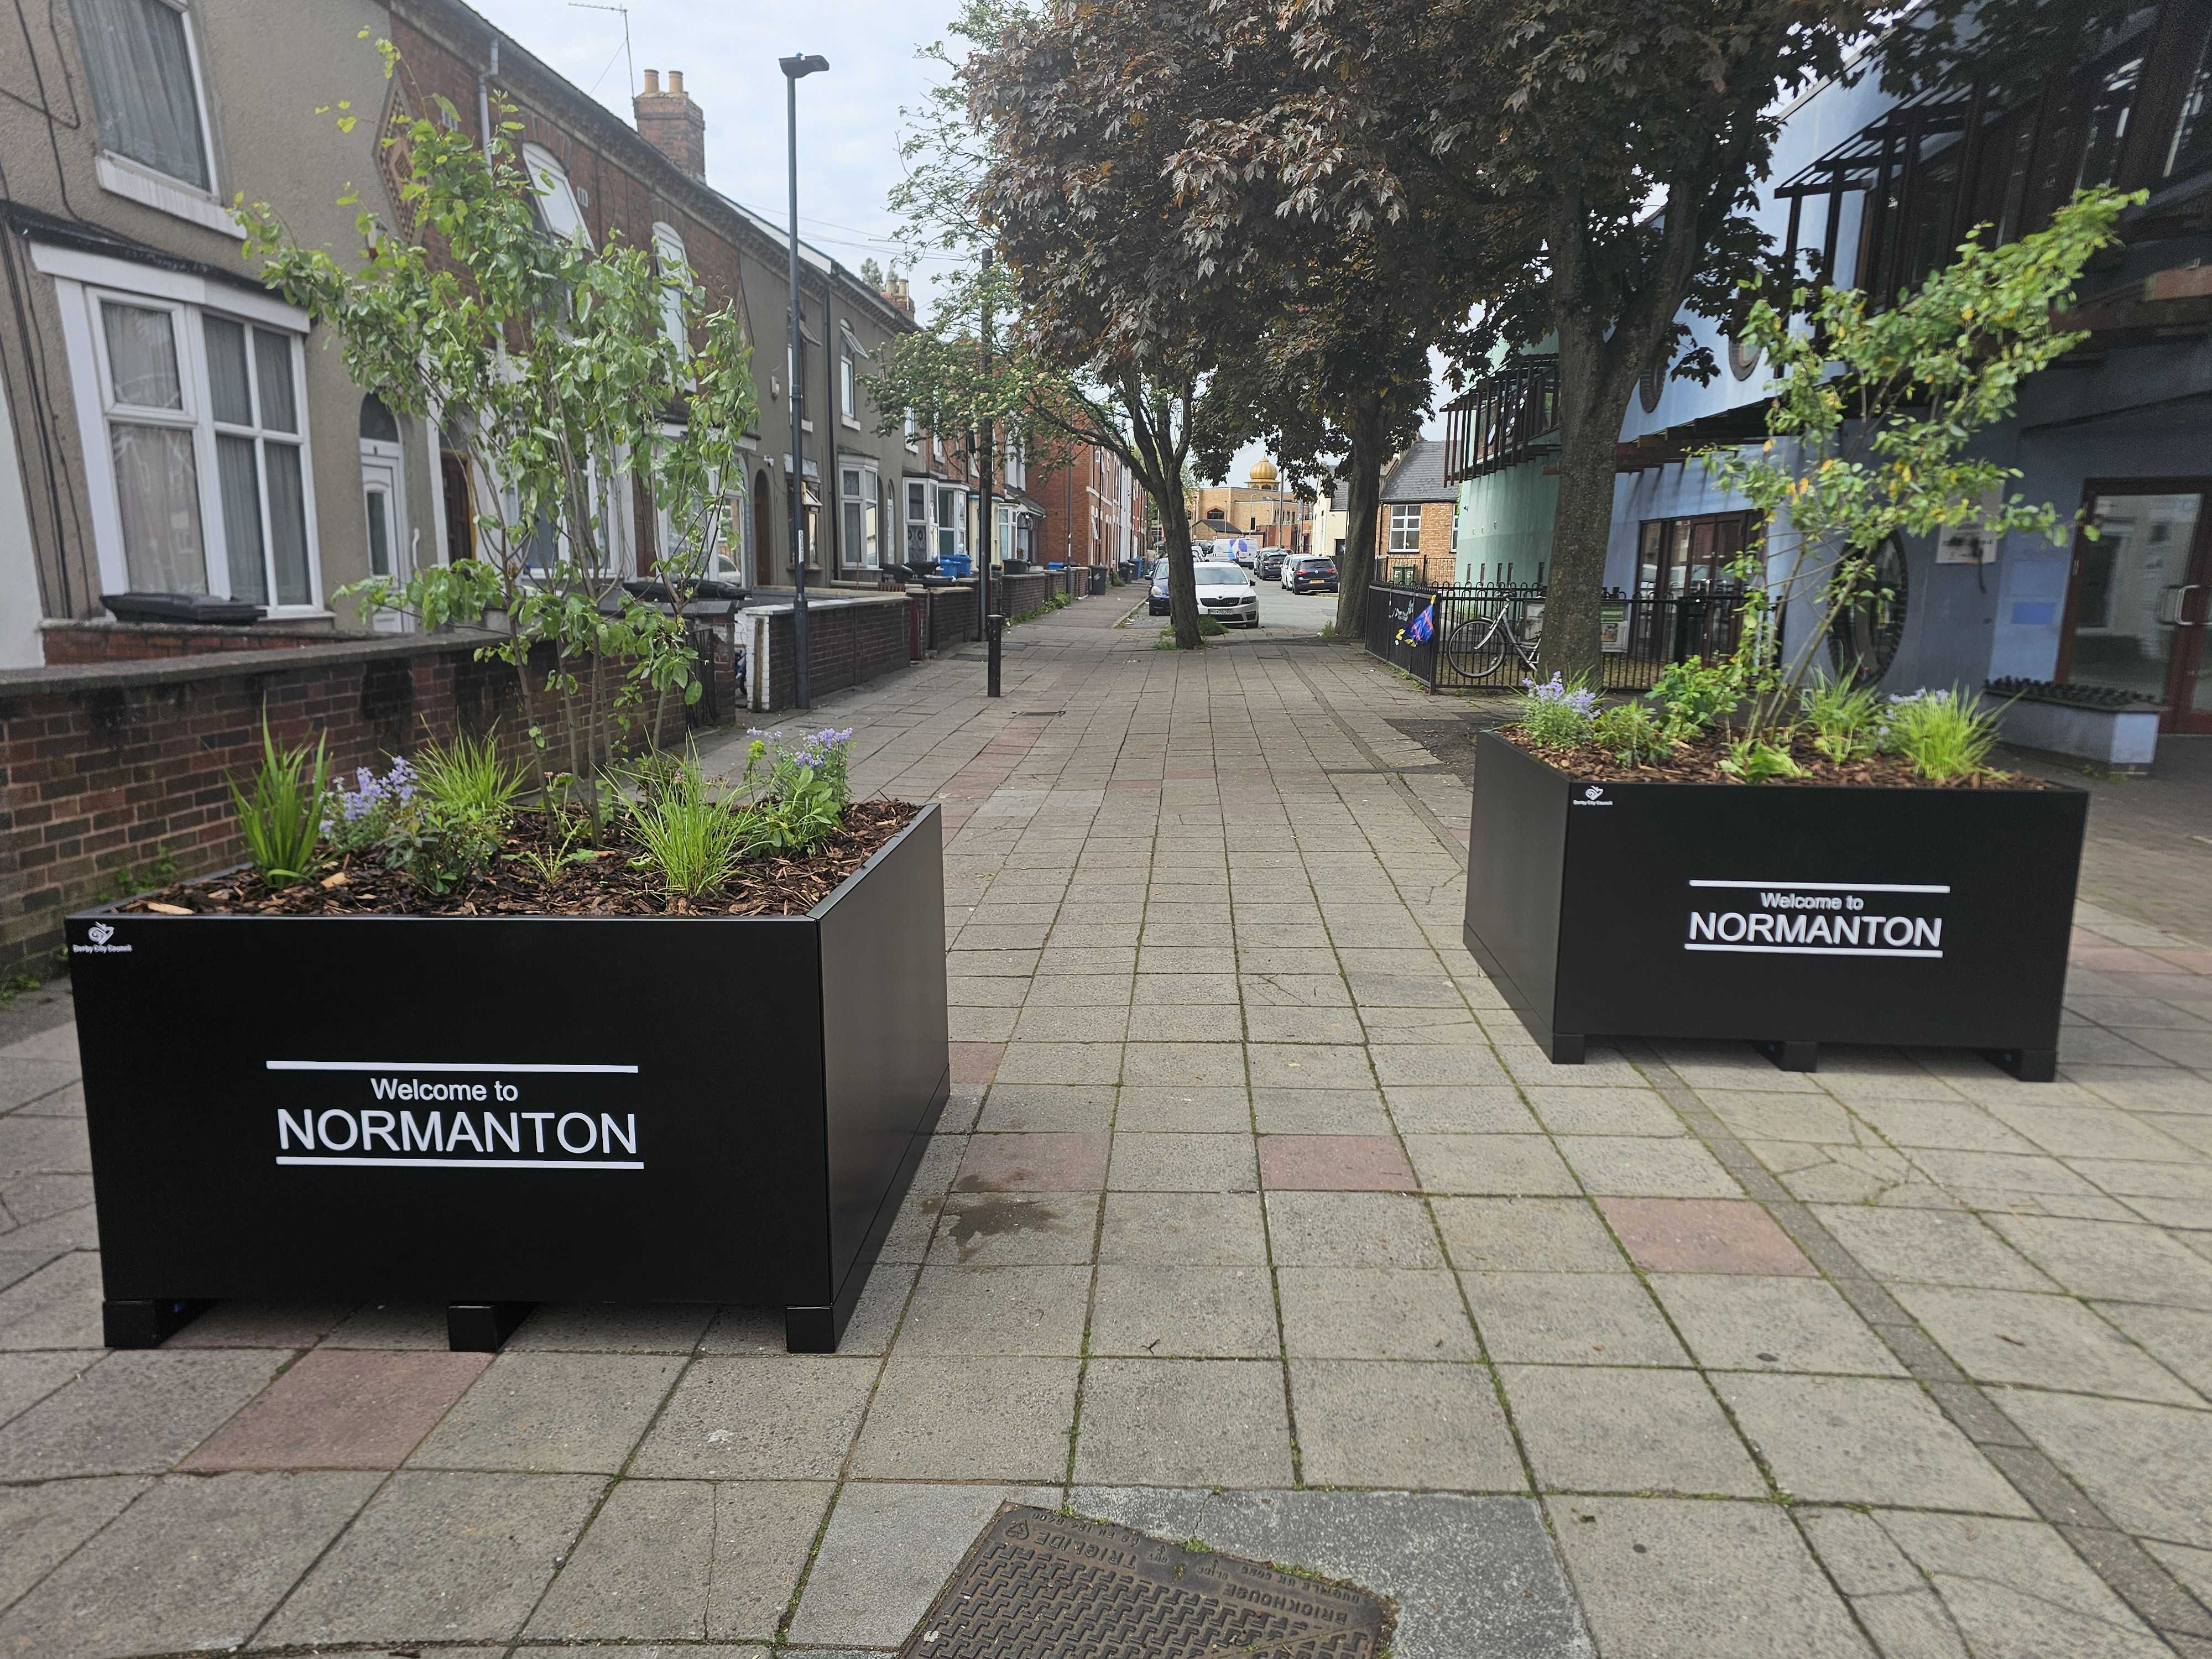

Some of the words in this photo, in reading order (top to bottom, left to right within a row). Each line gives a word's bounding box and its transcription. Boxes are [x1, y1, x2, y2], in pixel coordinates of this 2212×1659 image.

[1760, 892, 1842, 910] Welcome
[1845, 895, 1864, 911] to
[1689, 911, 1943, 947] NORMANTON
[370, 1078, 487, 1102] Welcome
[494, 1080, 519, 1102] to
[278, 1108, 637, 1154] NORMANTON
[1034, 1530, 1136, 1569] TRIGLIDE
[1222, 1583, 1349, 1626] BRICKHOUSE
